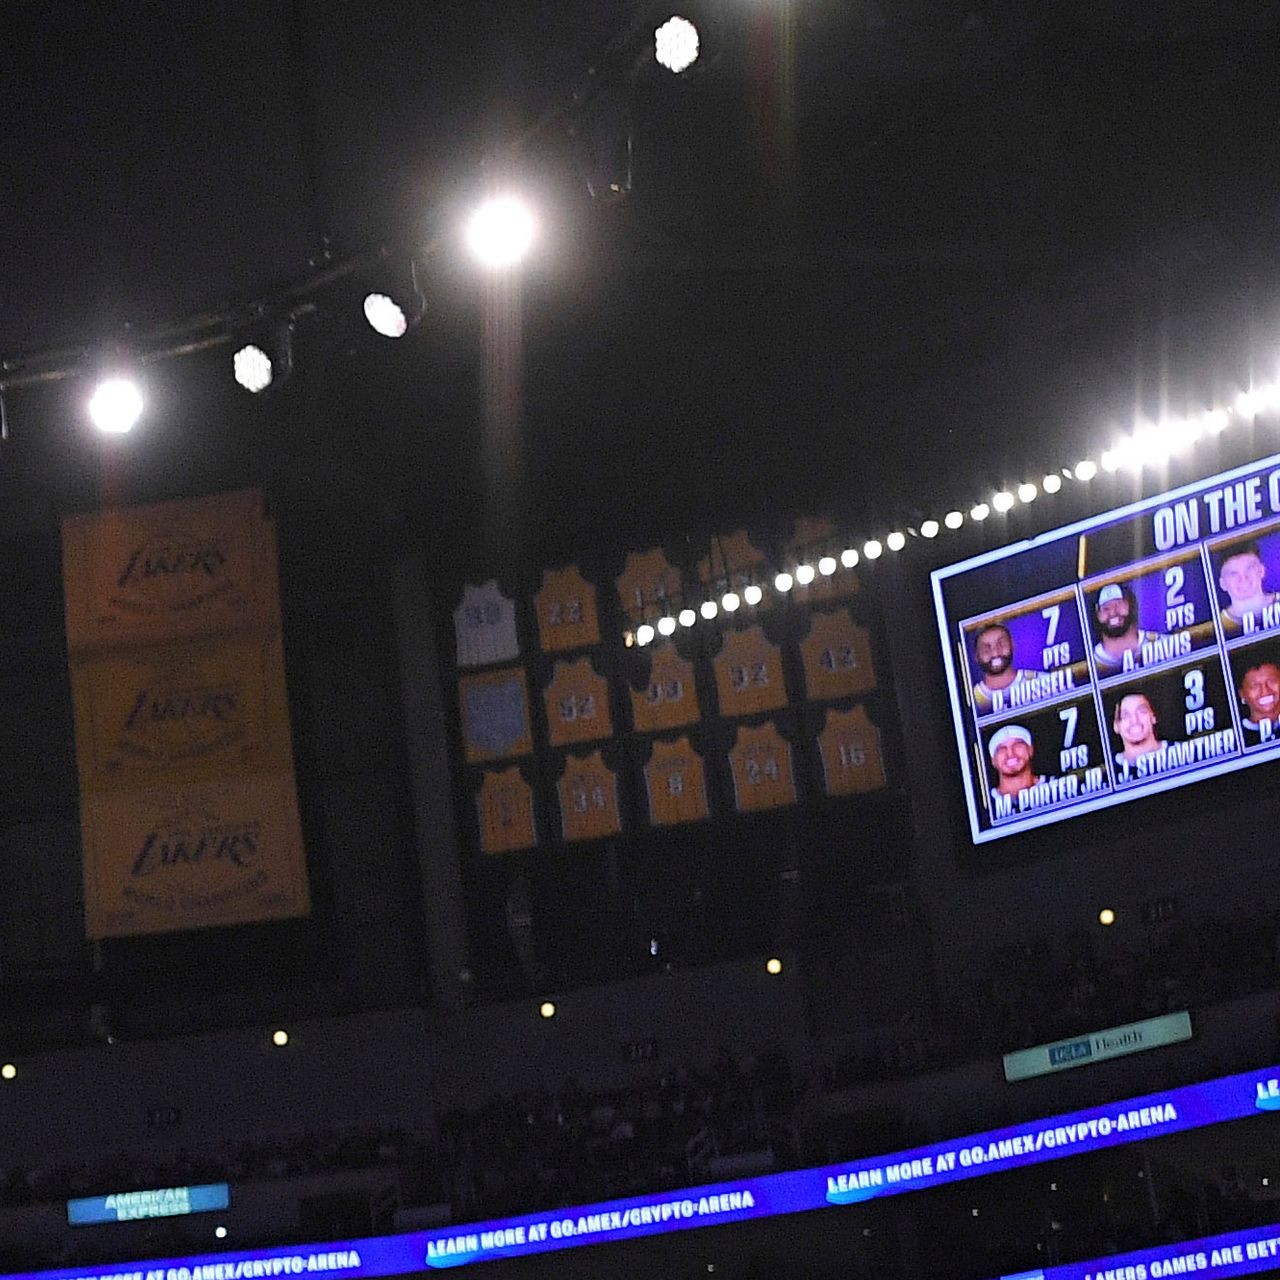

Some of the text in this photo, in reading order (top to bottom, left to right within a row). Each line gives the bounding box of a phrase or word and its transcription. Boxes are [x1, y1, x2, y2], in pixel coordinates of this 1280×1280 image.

[1154, 477, 1263, 551] ON THE
[1164, 567, 1185, 606] 2
[1042, 607, 1061, 645] 7
[1166, 602, 1195, 632] PTS
[1043, 641, 1071, 670] PTS
[1142, 632, 1192, 667] DAVIS
[1009, 667, 1076, 707] RUSSELL
[1184, 669, 1205, 710] 3
[1058, 706, 1078, 748] 7
[1185, 706, 1214, 736] PTS
[1060, 742, 1089, 772] PTS
[1019, 775, 1079, 811] PORTER
[827, 1168, 883, 1193] LEARN
[886, 1156, 934, 1182] MORE
[936, 1151, 957, 1174] AT
[105, 1186, 191, 1209] AMERICAN
[426, 1234, 479, 1258] LEARN
[481, 1226, 526, 1250] MORE
[528, 1222, 549, 1243] AT
[1150, 1252, 1208, 1280] GAMES
[1211, 1245, 1244, 1268] ARE
